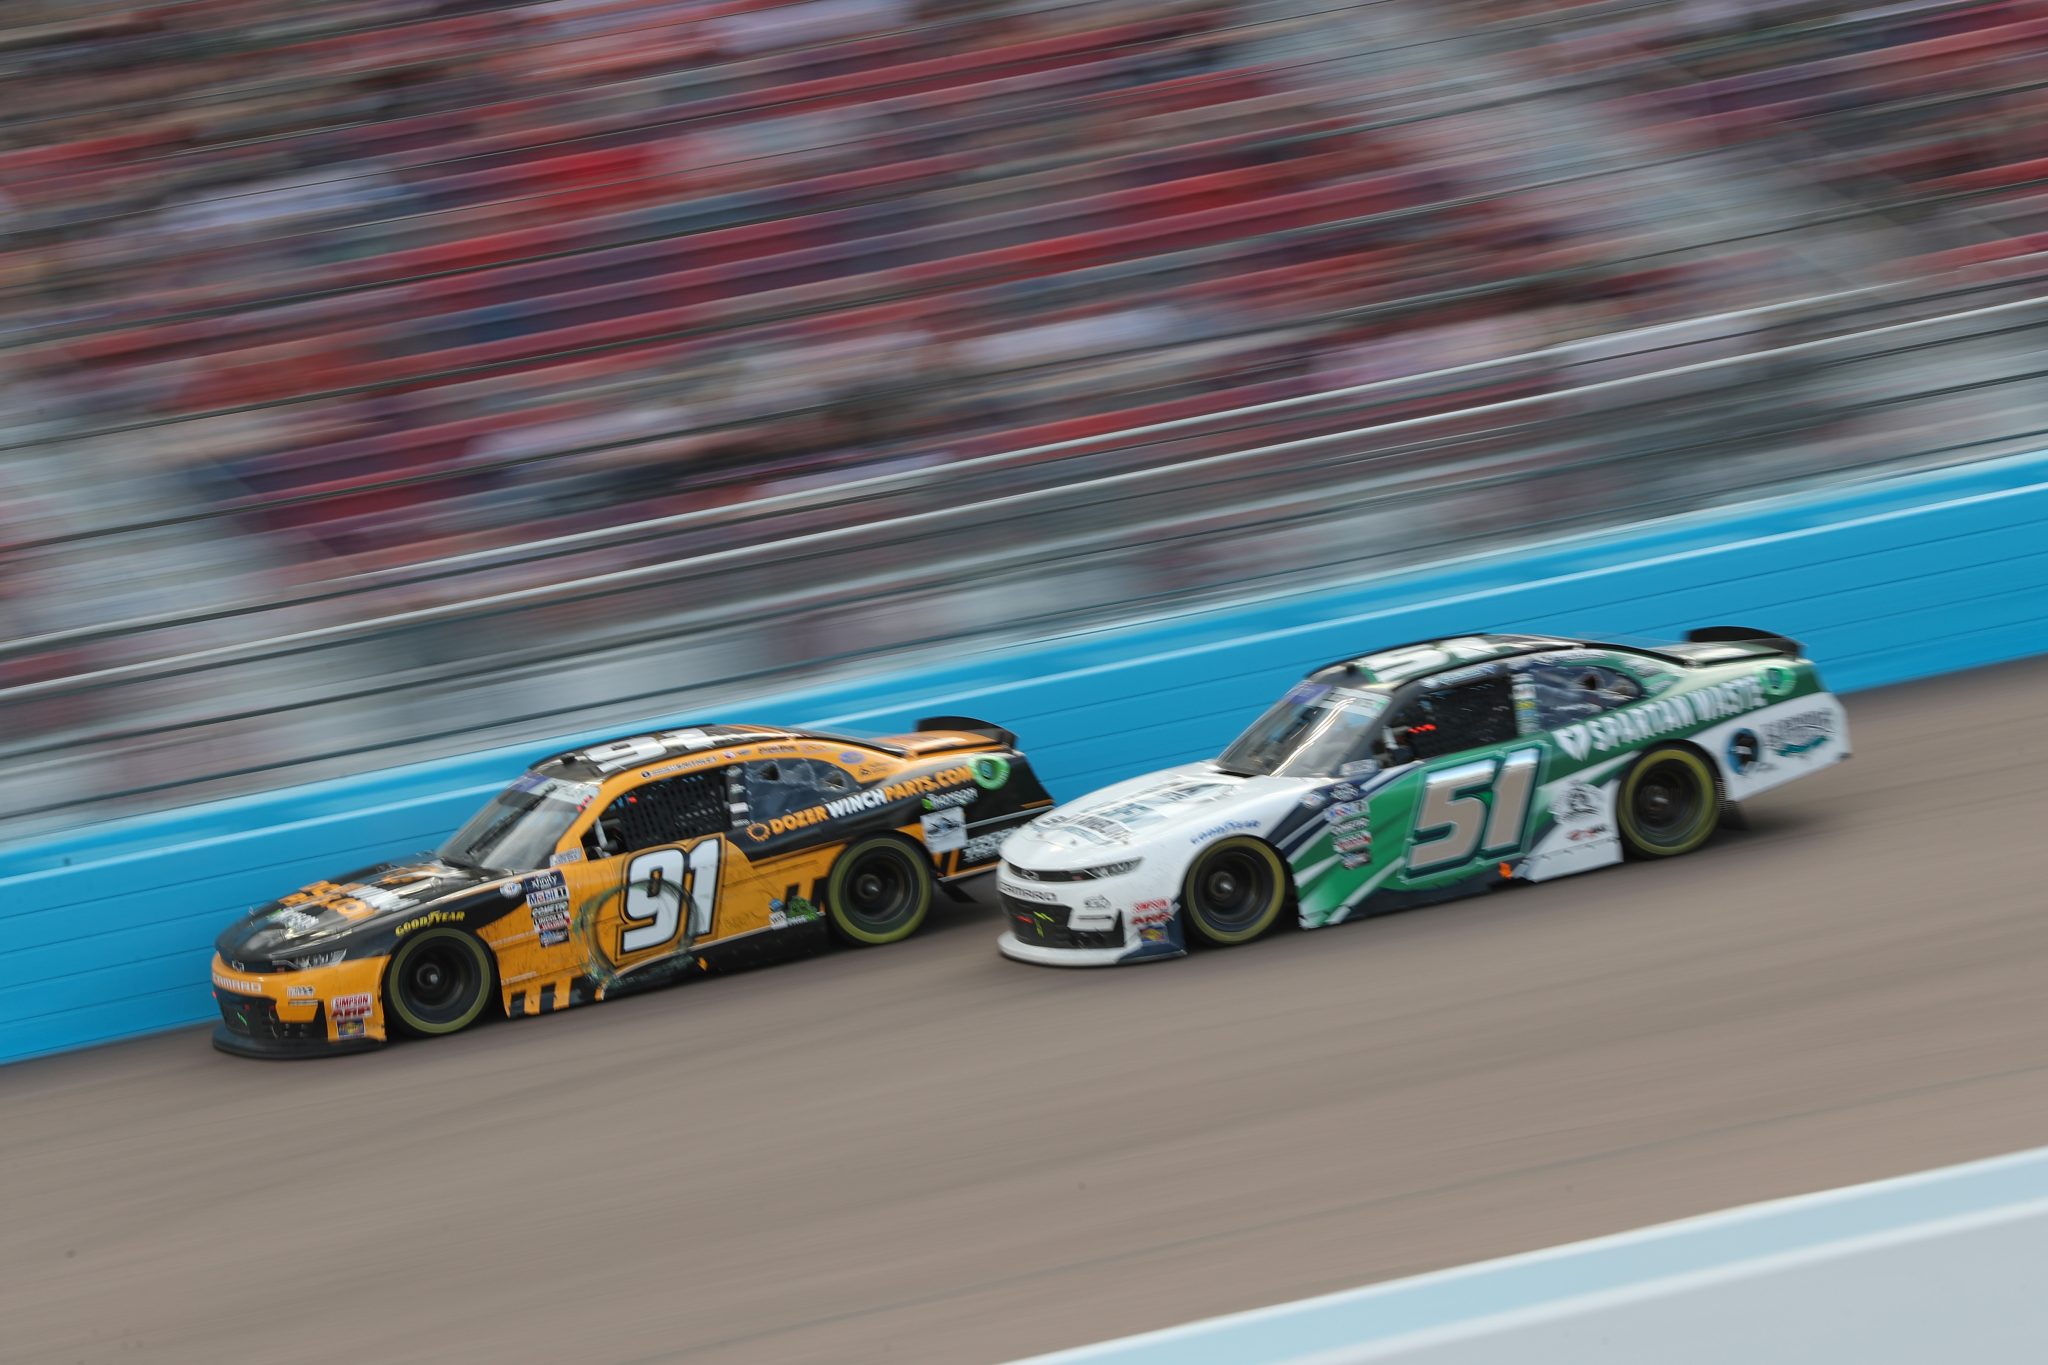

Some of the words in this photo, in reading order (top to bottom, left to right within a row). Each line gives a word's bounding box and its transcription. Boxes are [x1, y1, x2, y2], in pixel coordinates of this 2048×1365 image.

[1586, 695, 1697, 751] SPARTAN
[1409, 748, 1541, 870] 51
[395, 910, 466, 937] GOODYEAR
[529, 888, 557, 905] Mobil
[621, 838, 721, 953] 91
